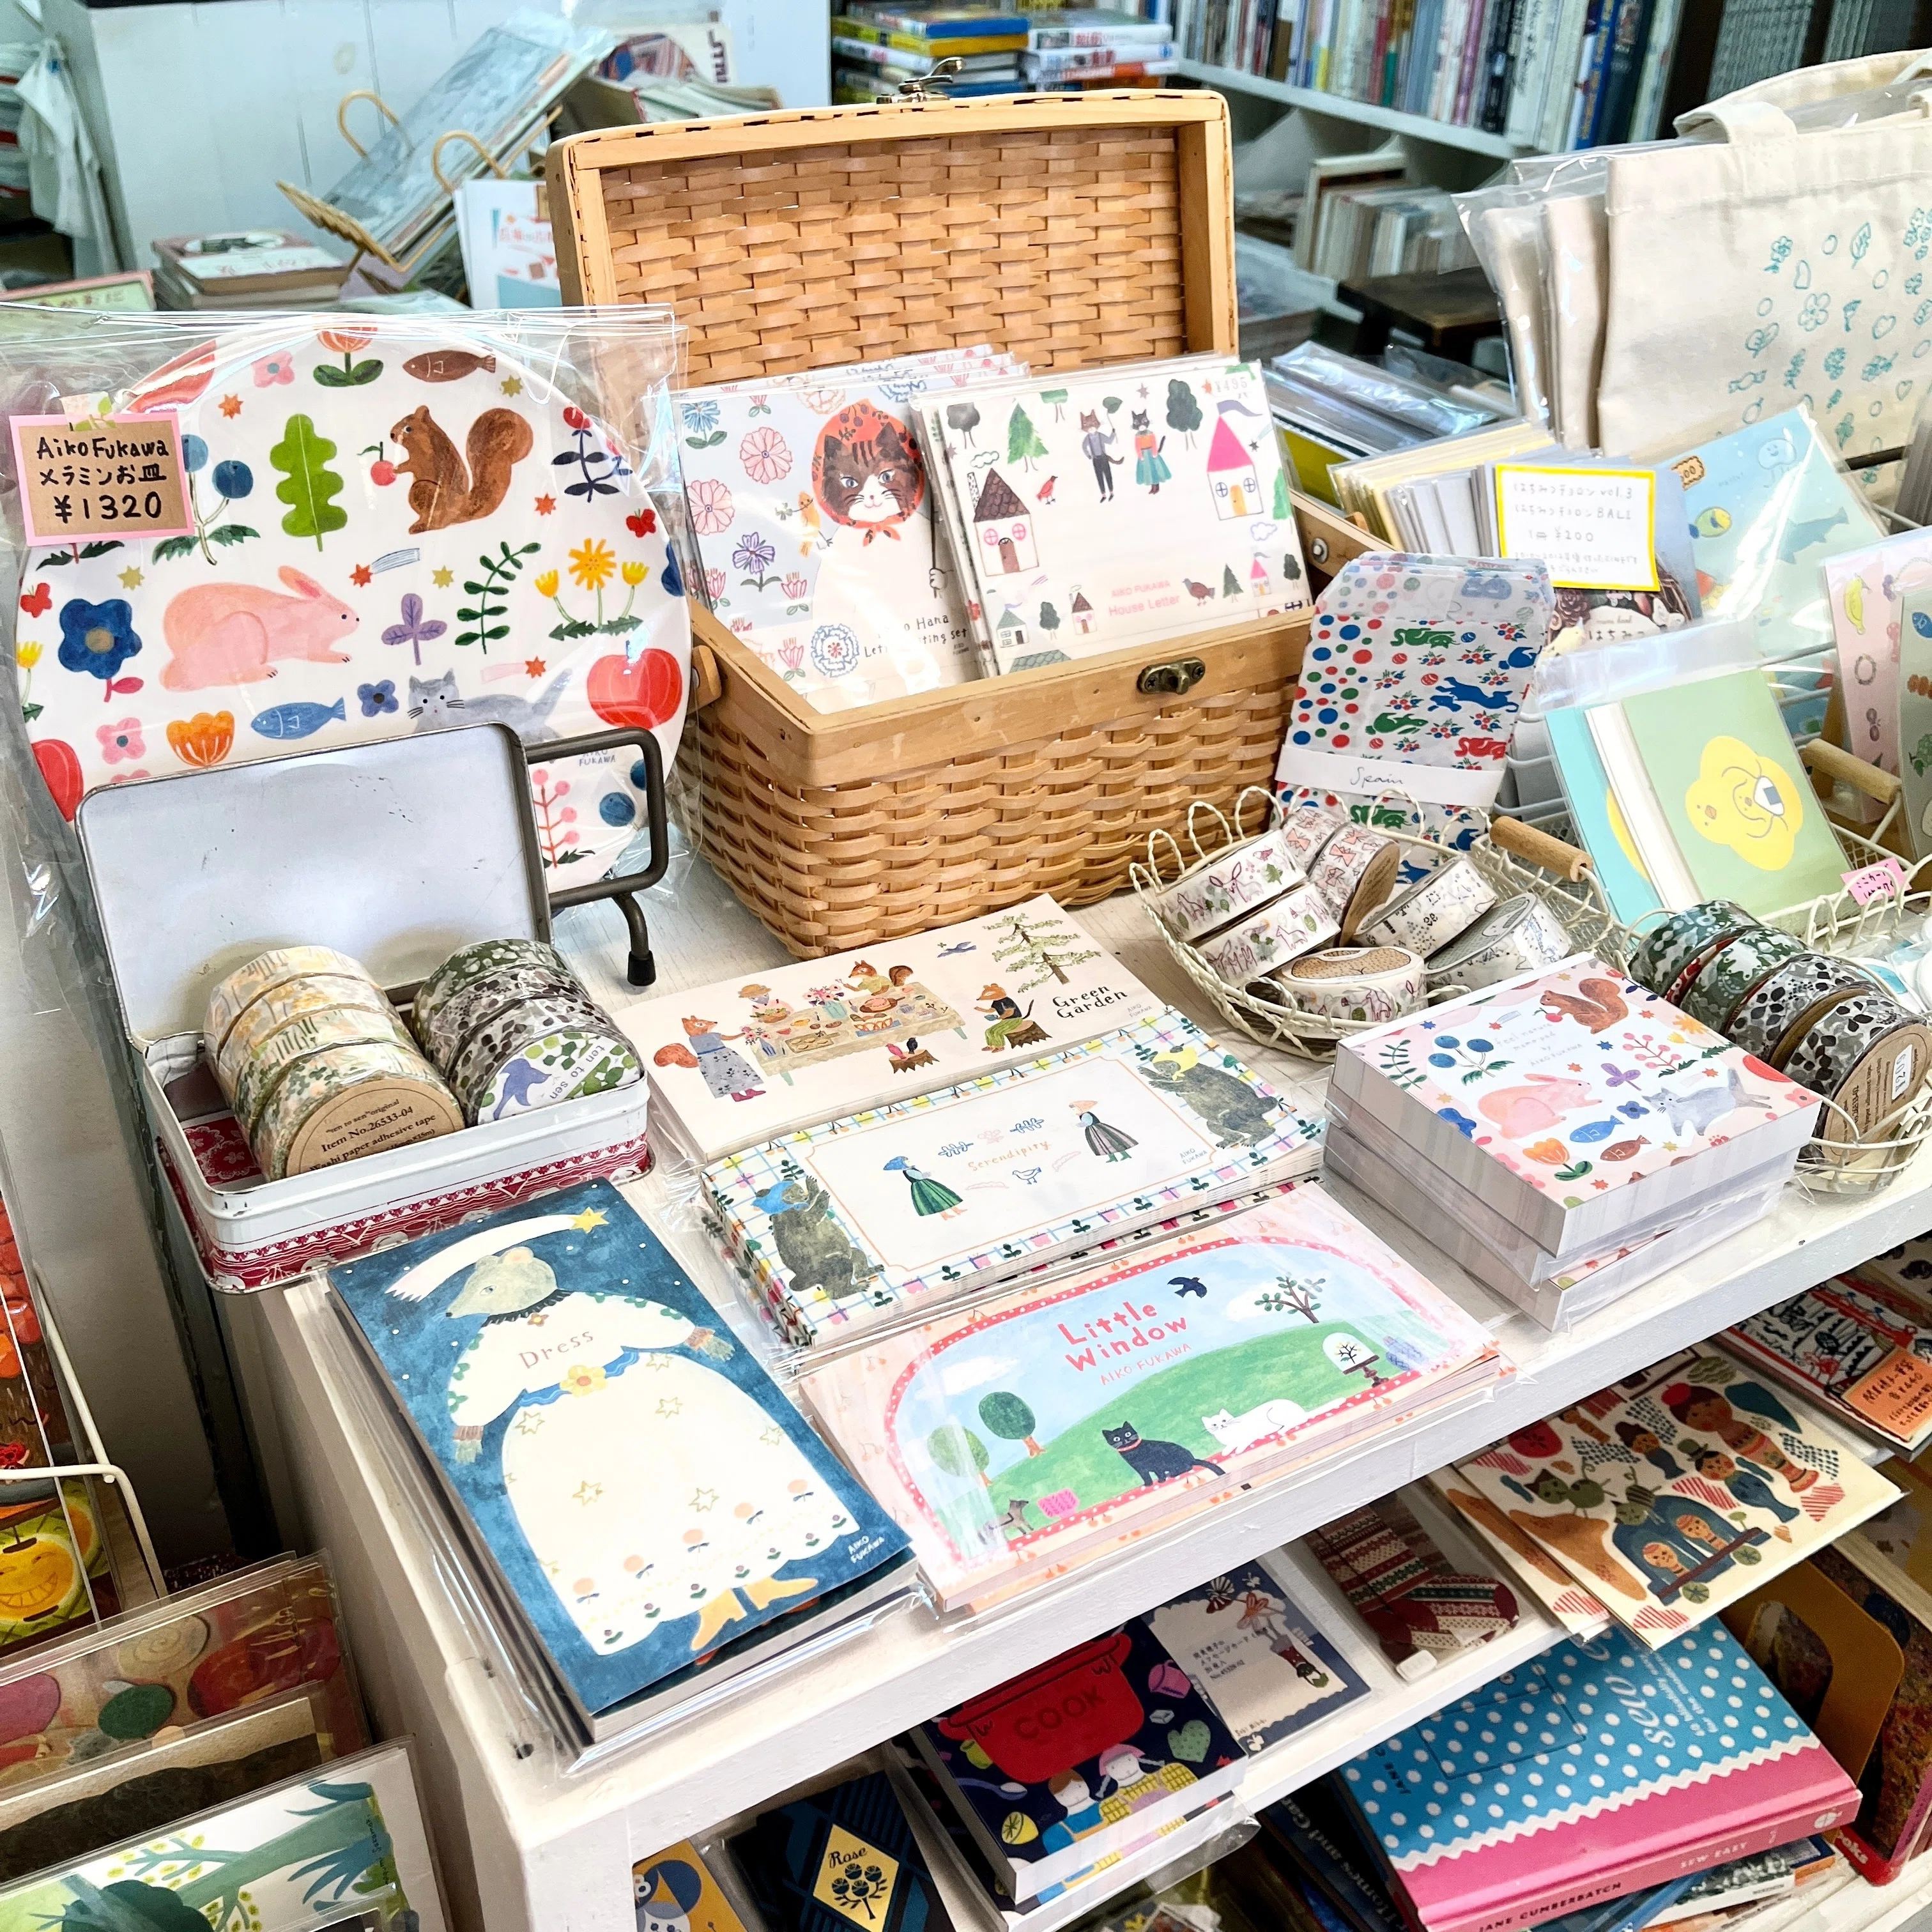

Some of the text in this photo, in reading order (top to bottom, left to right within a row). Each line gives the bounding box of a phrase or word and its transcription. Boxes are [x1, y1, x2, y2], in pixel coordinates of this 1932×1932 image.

[39, 463, 167, 486] メラミンお皿
[54, 491, 162, 523] ¥1320
[1108, 595, 1180, 617] House Letter
[951, 628, 967, 640] set
[579, 755, 616, 767] FUKAWA
[1350, 767, 1403, 788] Spain
[1052, 986, 1110, 1008] Green
[1057, 990, 1128, 1018] Garden
[549, 1045, 605, 1099] ten to sen
[321, 1105, 414, 1153] Item No.26533-04
[342, 1142, 371, 1161] paper
[372, 1123, 414, 1146] adhesive
[415, 1114, 437, 1127] tape
[968, 1141, 1050, 1171] Serendipity
[1180, 1148, 1195, 1159] AIKO
[1183, 1150, 1208, 1165] FUKAWA
[1057, 1301, 1157, 1345] Little
[518, 1331, 594, 1368] Dress
[1065, 1317, 1187, 1372] Window
[1100, 1343, 1192, 1385] AIKO FUKAWA
[848, 1535, 869, 1555] AIKO
[850, 1536, 885, 1564] FUKAWA
[1013, 1685, 1107, 1740] COOK
[1604, 1676, 1676, 1748] sew
[828, 1846, 868, 1869] Rose
[1478, 1882, 1622, 1932] JANE CUMBERBATCH
